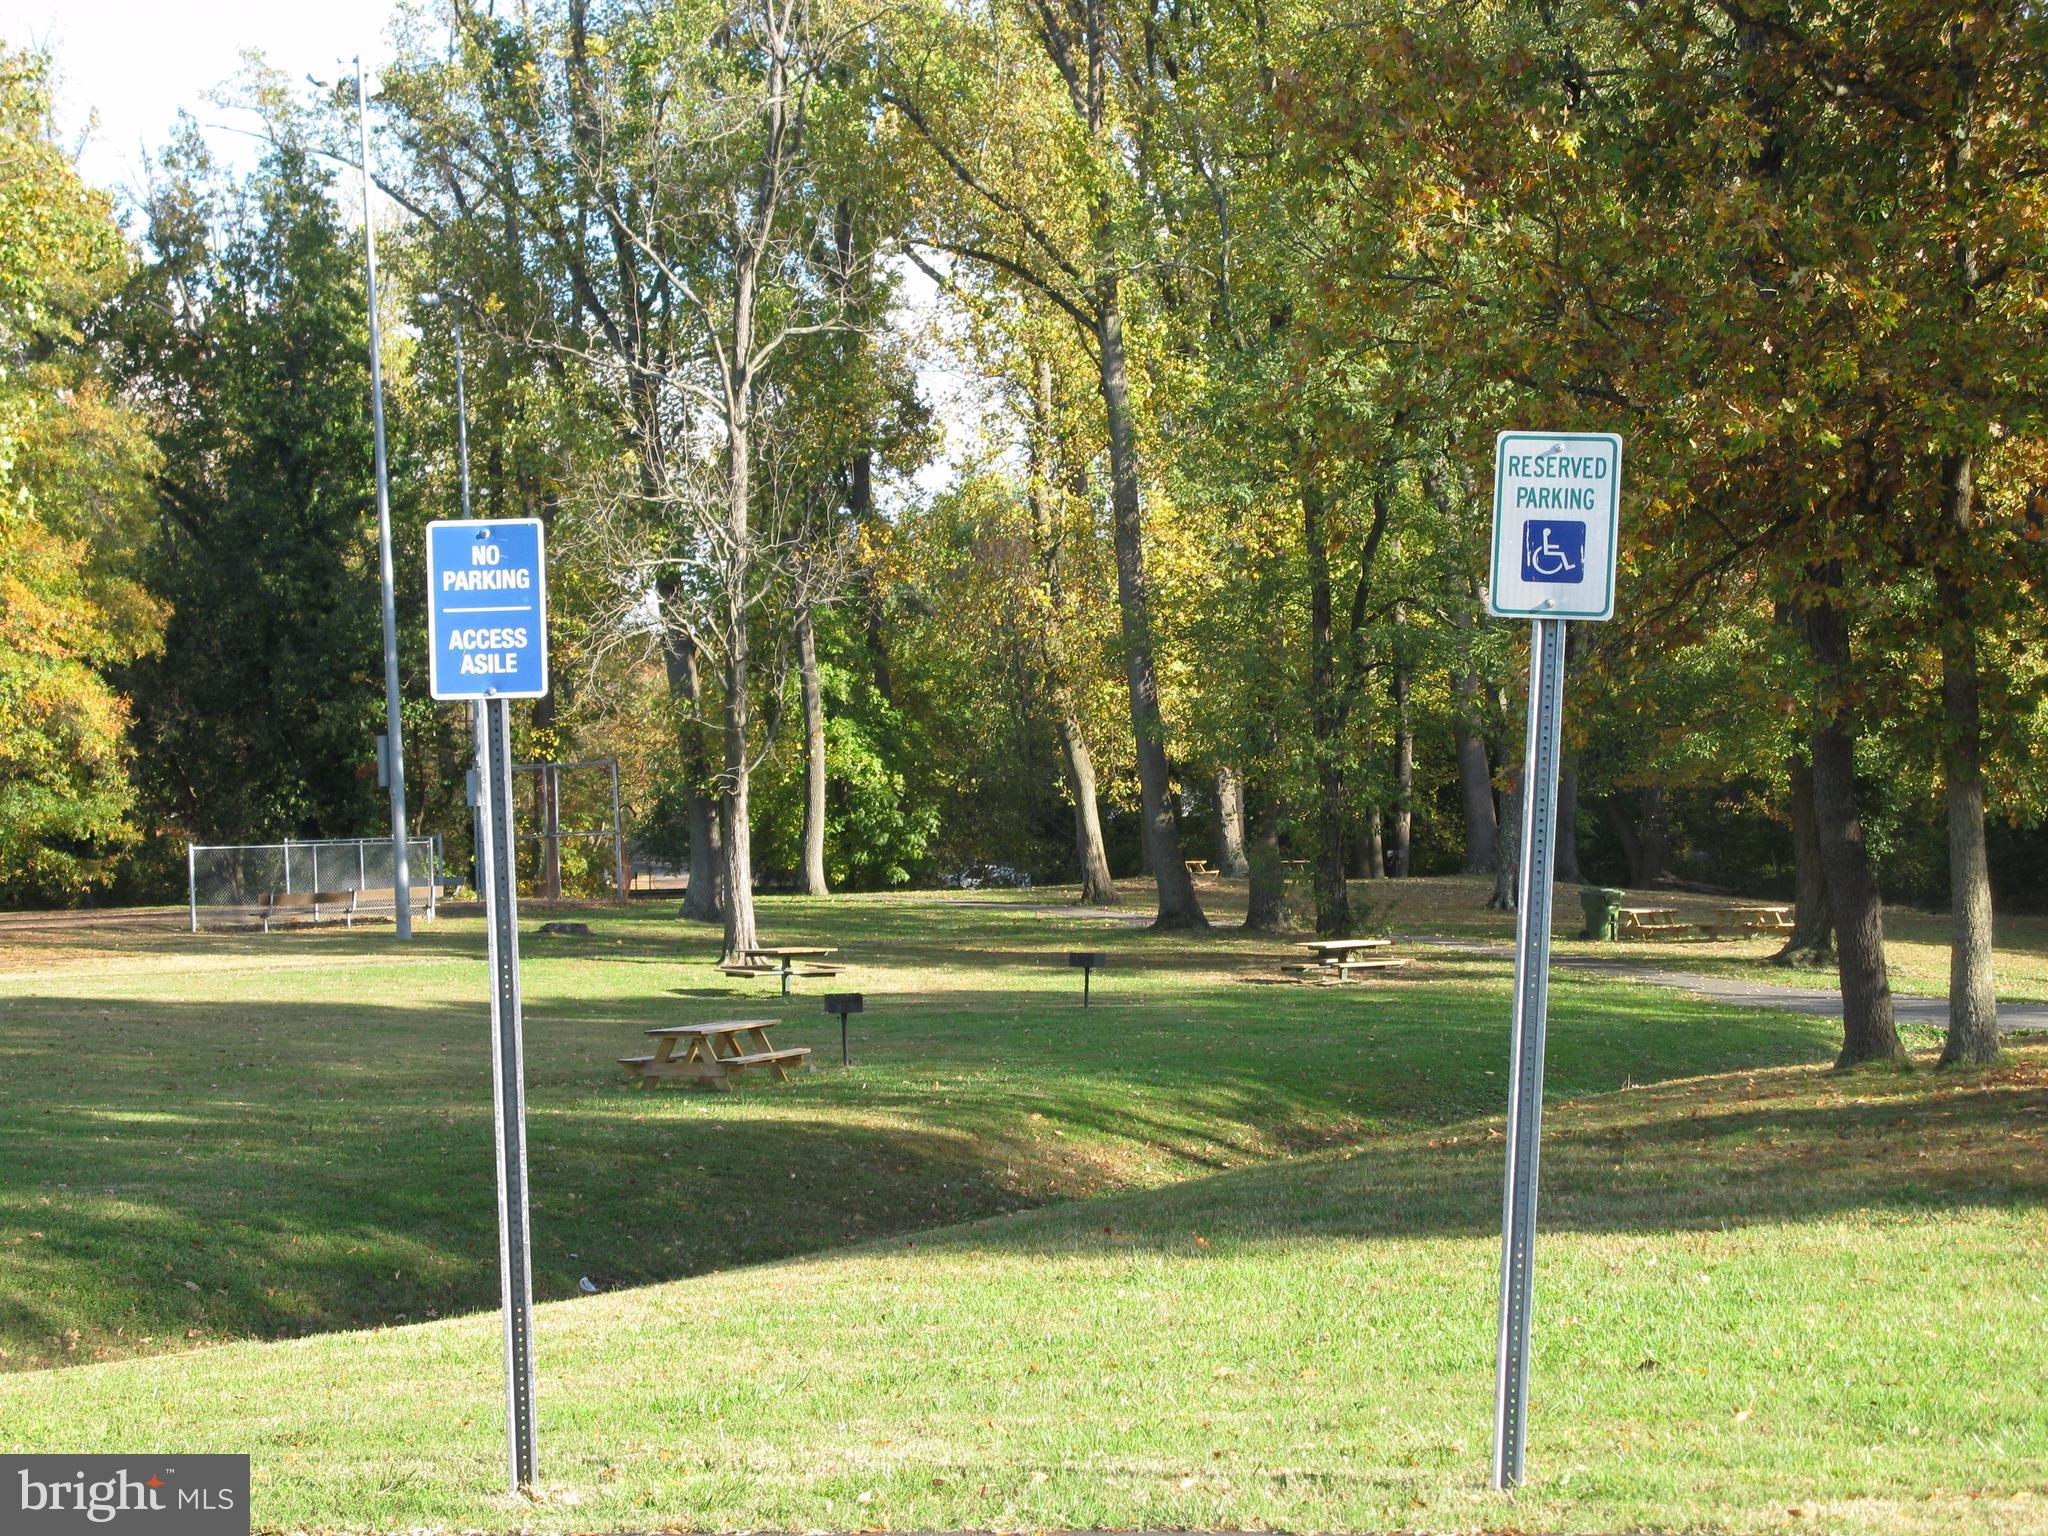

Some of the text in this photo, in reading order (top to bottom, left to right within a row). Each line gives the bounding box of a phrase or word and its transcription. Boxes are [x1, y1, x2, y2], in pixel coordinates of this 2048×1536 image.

[1508, 455, 1607, 479] RESERVED
[1516, 486, 1595, 510] PARKING
[471, 545, 500, 566] NO
[442, 568, 530, 592] PARKING
[448, 628, 528, 651] ACCESS
[460, 652, 518, 675] ASILE
